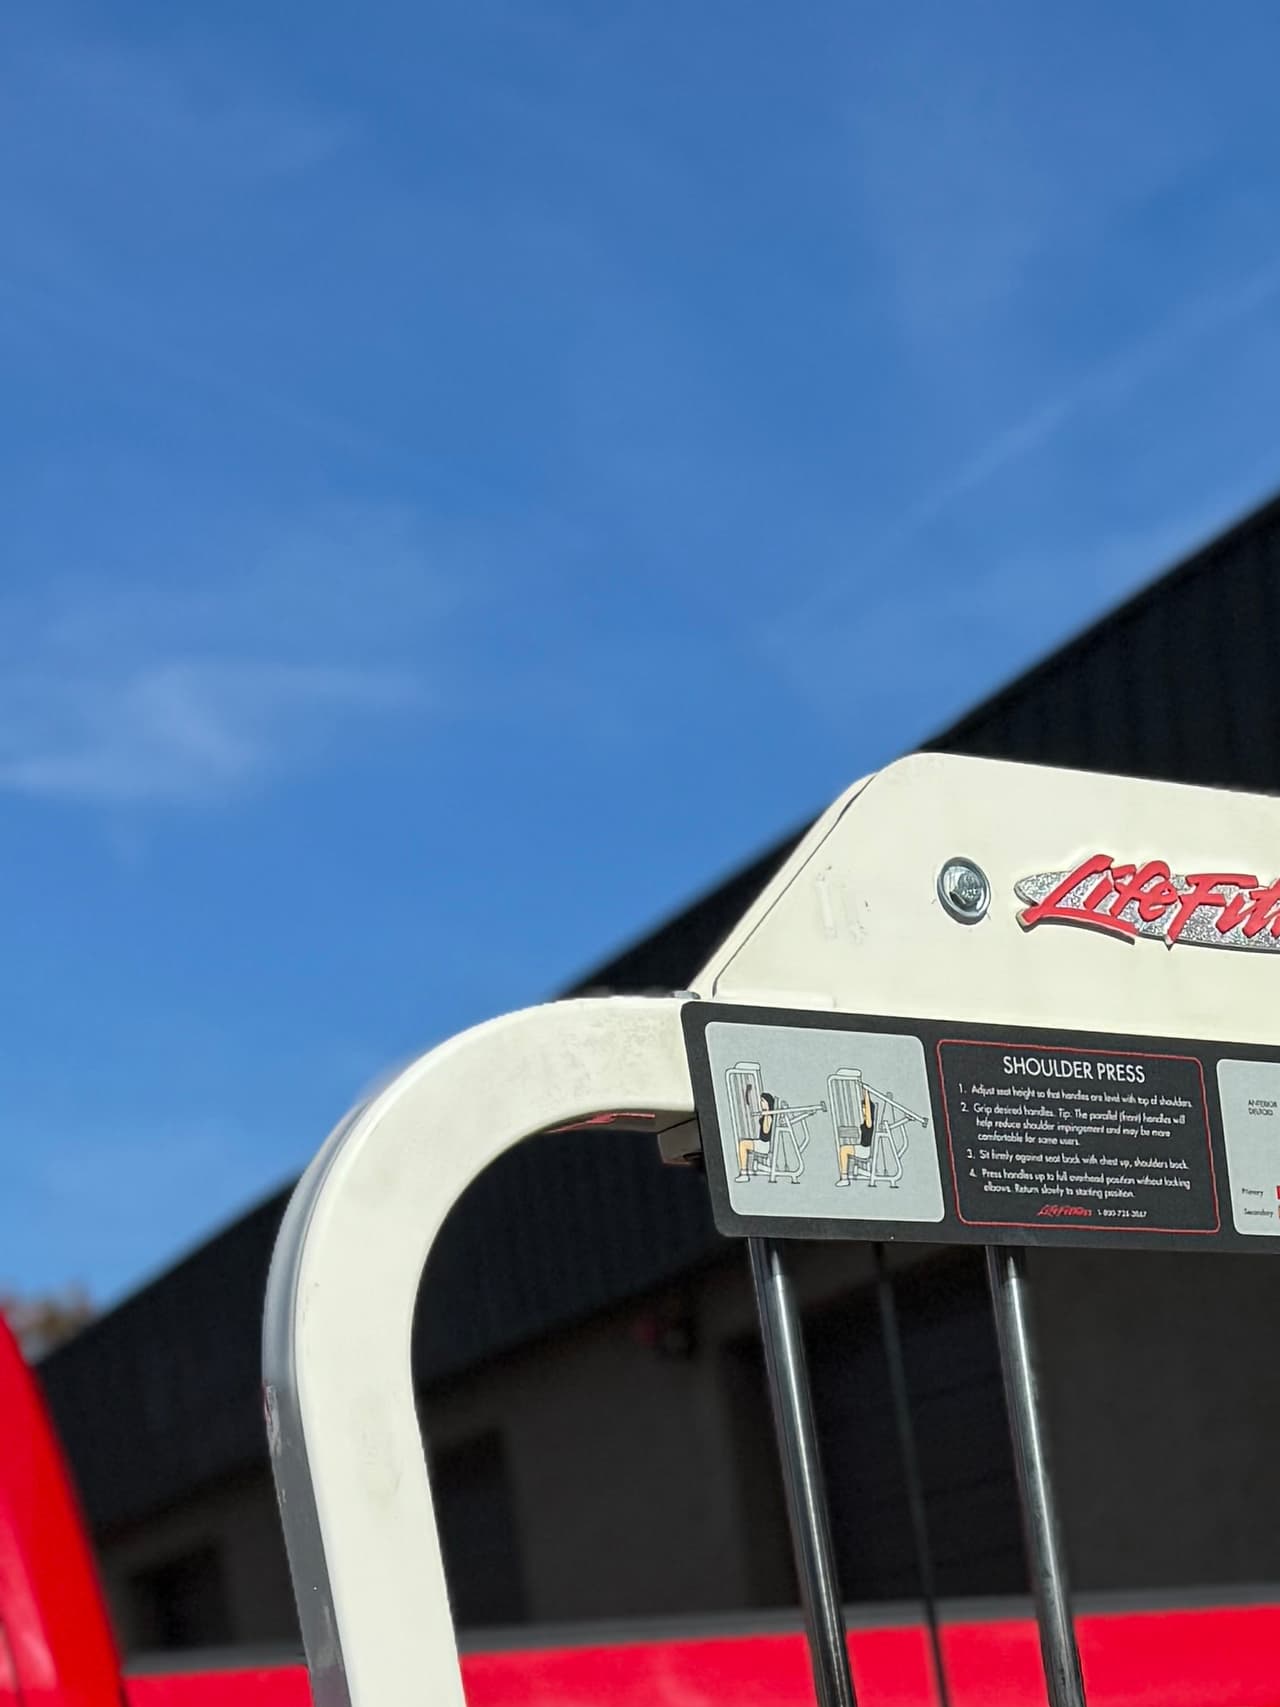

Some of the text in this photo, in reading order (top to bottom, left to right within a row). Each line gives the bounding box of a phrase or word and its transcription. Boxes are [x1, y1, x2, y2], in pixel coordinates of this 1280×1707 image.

[1003, 1056, 1145, 1083] SHOULDER PRESS
[972, 1084, 995, 1096] Adjust
[1012, 1086, 1035, 1100] height
[1046, 1088, 1060, 1099] that
[1061, 1089, 1089, 1101] handles
[1122, 1093, 1136, 1103] with
[973, 1103, 992, 1116] Grip
[994, 1104, 1022, 1115] desired
[1075, 1109, 1087, 1119] The
[1143, 1113, 1171, 1124] handles
[976, 1116, 992, 1130] help
[995, 1118, 1021, 1129] reduce
[1023, 1120, 1054, 1131] shoulder
[1106, 1125, 1121, 1134] and
[1122, 1127, 1138, 1137] may
[1140, 1126, 1150, 1136] be
[977, 1131, 1022, 1142] comfortable
[1025, 1133, 1035, 1142] for
[980, 1149, 989, 1159] Sit
[991, 1149, 1013, 1162] firmly
[1015, 1153, 1043, 1163] against
[1045, 1154, 1060, 1162] seat
[1062, 1153, 1080, 1163] back
[1082, 1154, 1098, 1164] with
[1134, 1157, 1168, 1168] shoulders
[982, 1168, 1002, 1178] Press
[1003, 1169, 1033, 1180] handles
[1035, 1174, 1045, 1182] up
[1047, 1172, 1054, 1180] to
[1015, 1183, 1039, 1193] Return
[1041, 1184, 1064, 1196] slowly
[1065, 1187, 1073, 1195] to
[1075, 1187, 1103, 1199] starting
